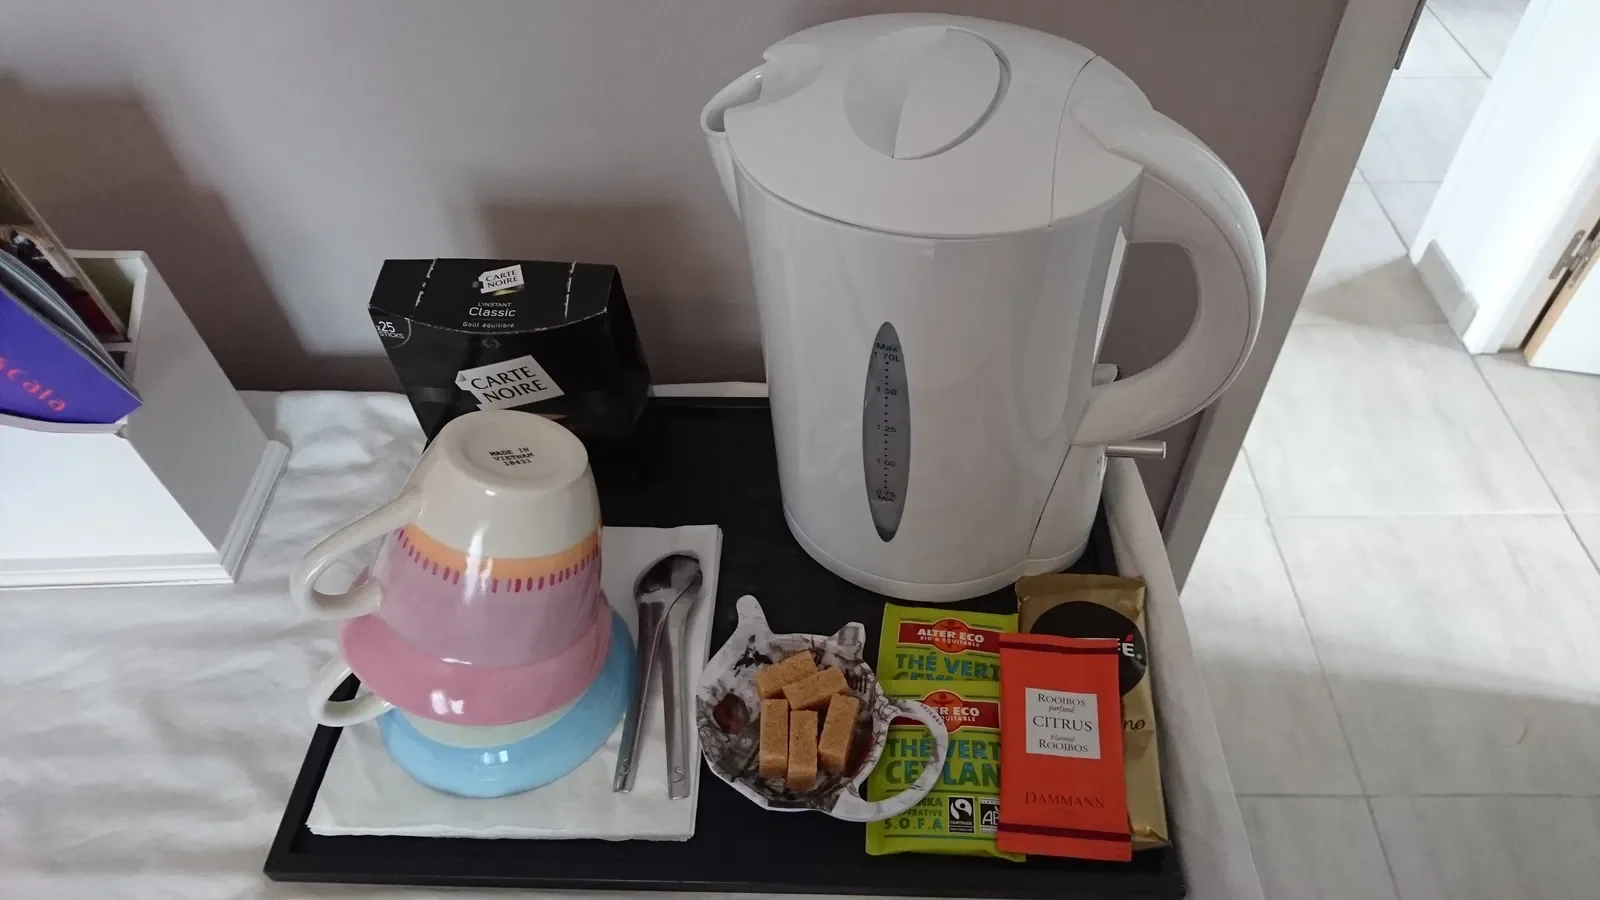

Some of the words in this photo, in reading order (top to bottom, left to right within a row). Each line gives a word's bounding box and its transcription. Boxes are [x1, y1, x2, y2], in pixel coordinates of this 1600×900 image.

[485, 270, 517, 282] CARTE
[487, 276, 519, 288] NOIRE
[469, 307, 516, 317] Classic
[379, 330, 405, 339] STICKS
[876, 342, 898, 352] Max
[471, 366, 536, 390] CARTE
[482, 379, 548, 403] NOIRE
[489, 449, 514, 457] MADE
[493, 452, 535, 462] VIETNAM
[917, 628, 956, 639] ALTER
[959, 630, 985, 643] ECO
[942, 638, 980, 647] EQUITABLE
[895, 651, 937, 672] THÉ
[944, 656, 1000, 682] VERT
[1037, 693, 1086, 706] ROOIBOS
[953, 707, 980, 717] ECO
[1032, 715, 1092, 732] CITRUS
[886, 732, 932, 758] THÉ
[1038, 738, 1089, 752] ROOIBOS
[885, 760, 1000, 787] CELAN
[1025, 791, 1105, 809] DAMMANN
